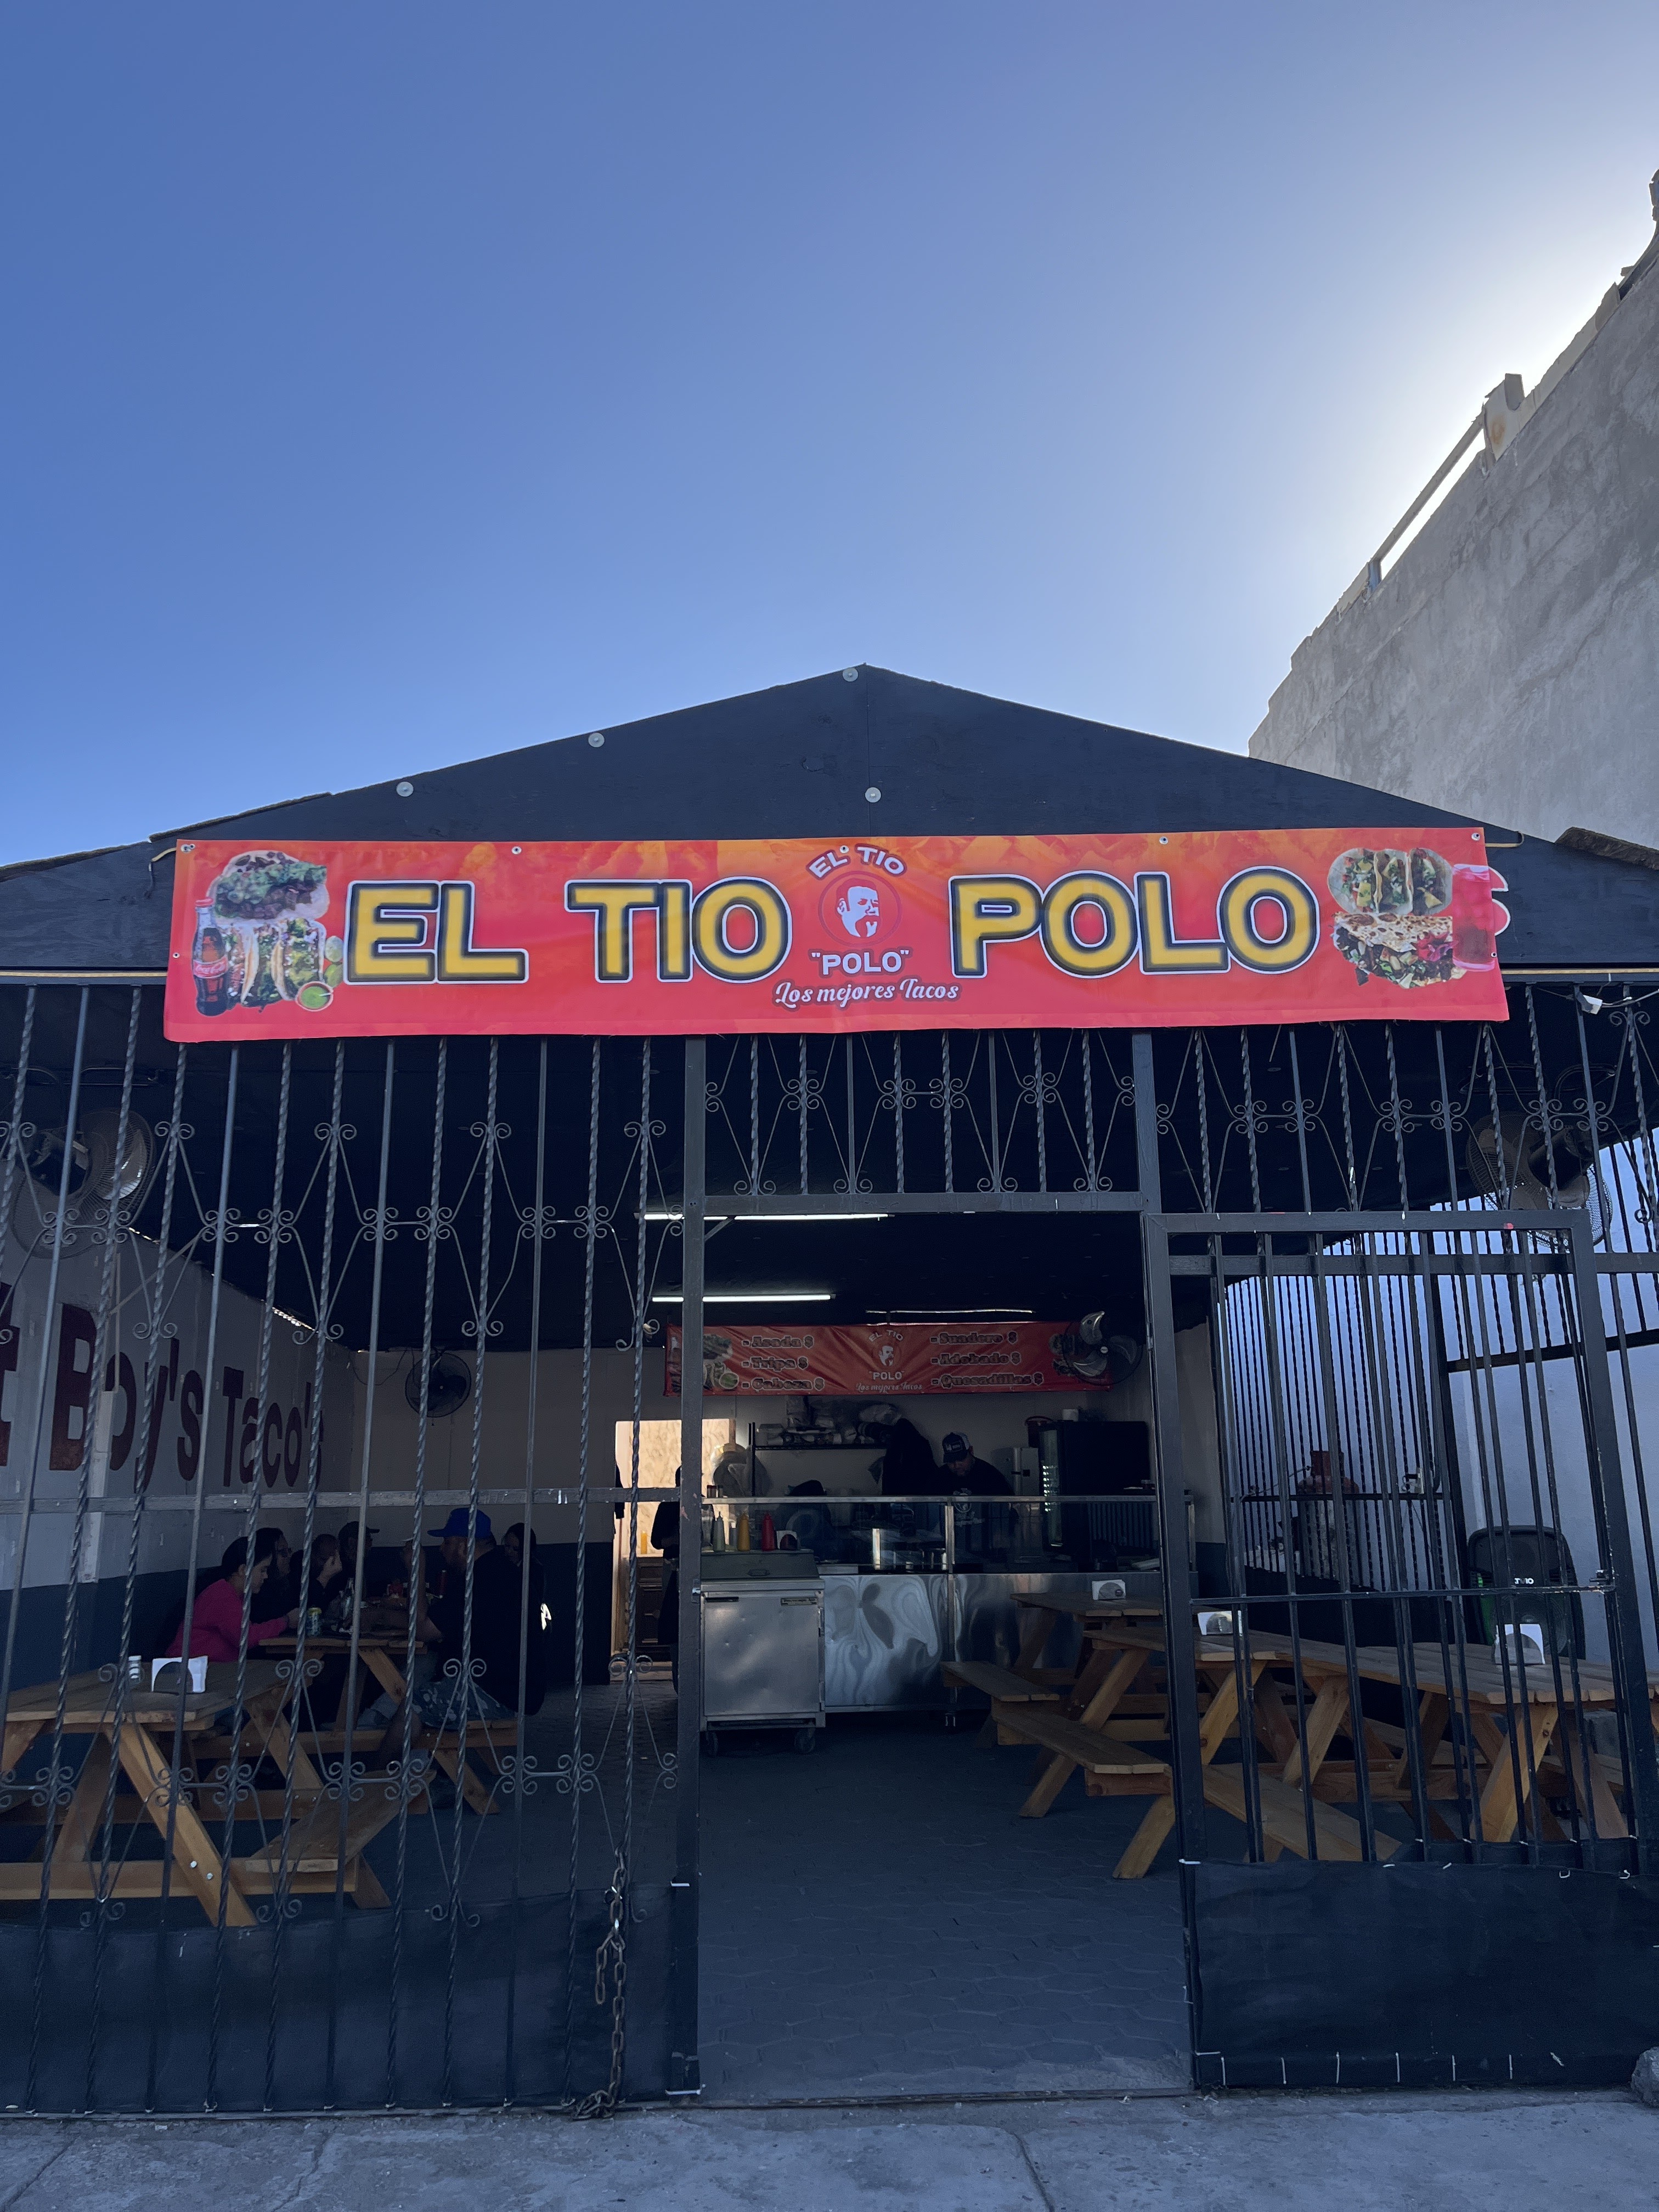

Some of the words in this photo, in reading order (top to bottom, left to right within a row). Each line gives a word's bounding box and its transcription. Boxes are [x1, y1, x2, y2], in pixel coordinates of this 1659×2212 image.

[809, 851, 848, 878] EL
[857, 847, 905, 875] TIO
[343, 880, 529, 985] EL
[565, 876, 792, 983] TIO
[948, 865, 1320, 979] POLO
[811, 950, 910, 975] "POLO"
[775, 982, 814, 1009] Los
[816, 984, 895, 1008] mejores
[899, 978, 960, 999] Tacos
[868, 1332, 883, 1342] EL
[887, 1329, 904, 1341] TIO
